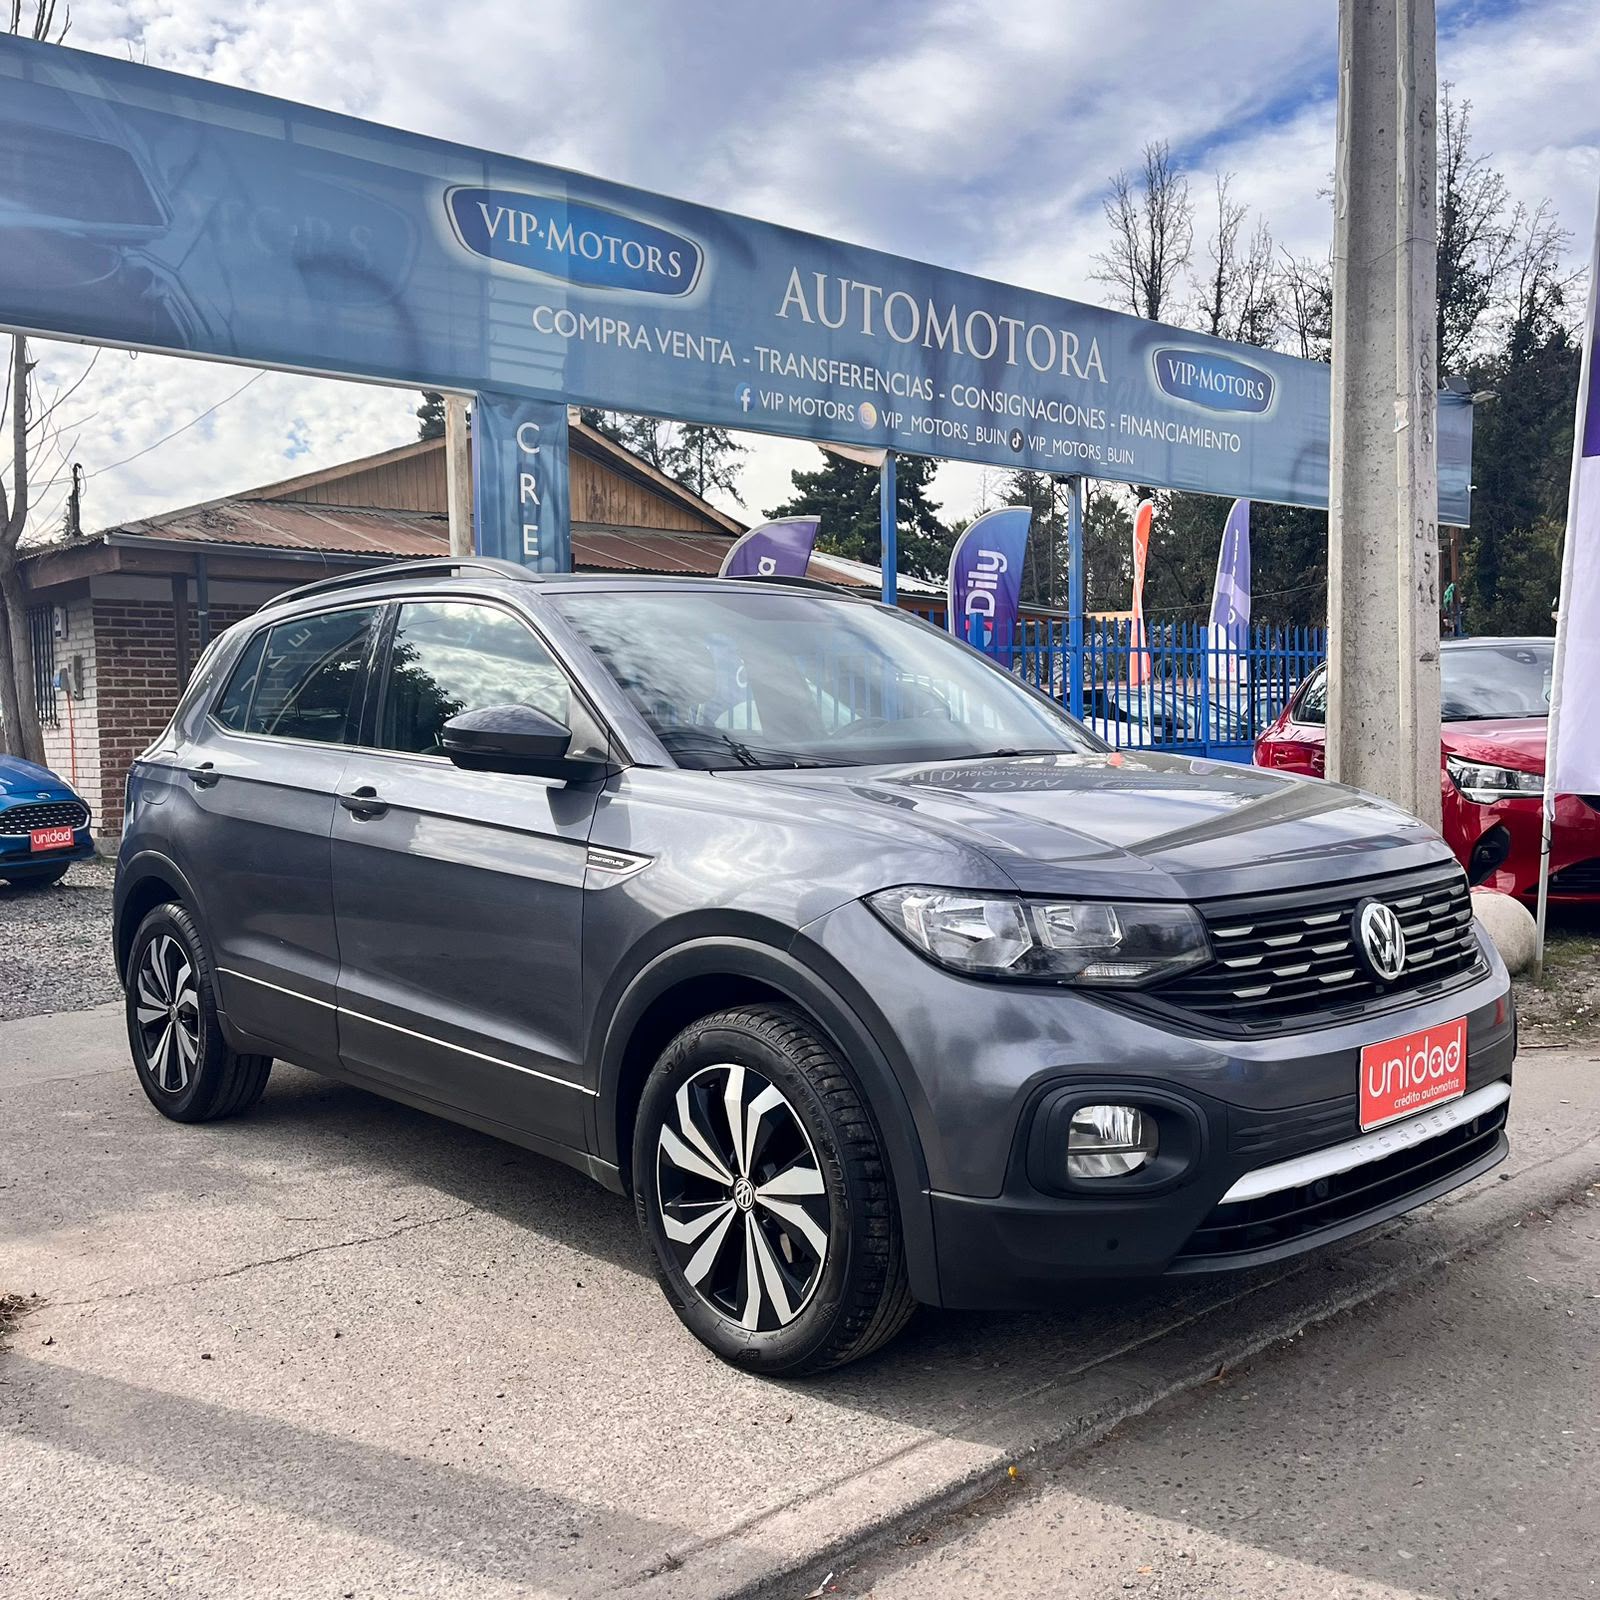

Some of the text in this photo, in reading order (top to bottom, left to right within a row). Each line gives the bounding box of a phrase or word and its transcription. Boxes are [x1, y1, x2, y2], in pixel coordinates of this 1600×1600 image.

[775, 266, 1109, 384] AUTOMOTORA
[532, 305, 652, 352] COMPRA
[655, 327, 736, 367] VENTA
[754, 346, 934, 401] TRANSFERENCIAS
[951, 384, 1106, 430] CONSIGNACIONES
[1120, 414, 1241, 453] FINANCIAMIENTO
[759, 390, 784, 411] VIP
[789, 395, 855, 422] MOTORS
[965, 550, 1008, 617] Dily
[34, 828, 71, 844] unidad
[1369, 1026, 1461, 1097] unidad
[1421, 1078, 1459, 1099] automotriz
